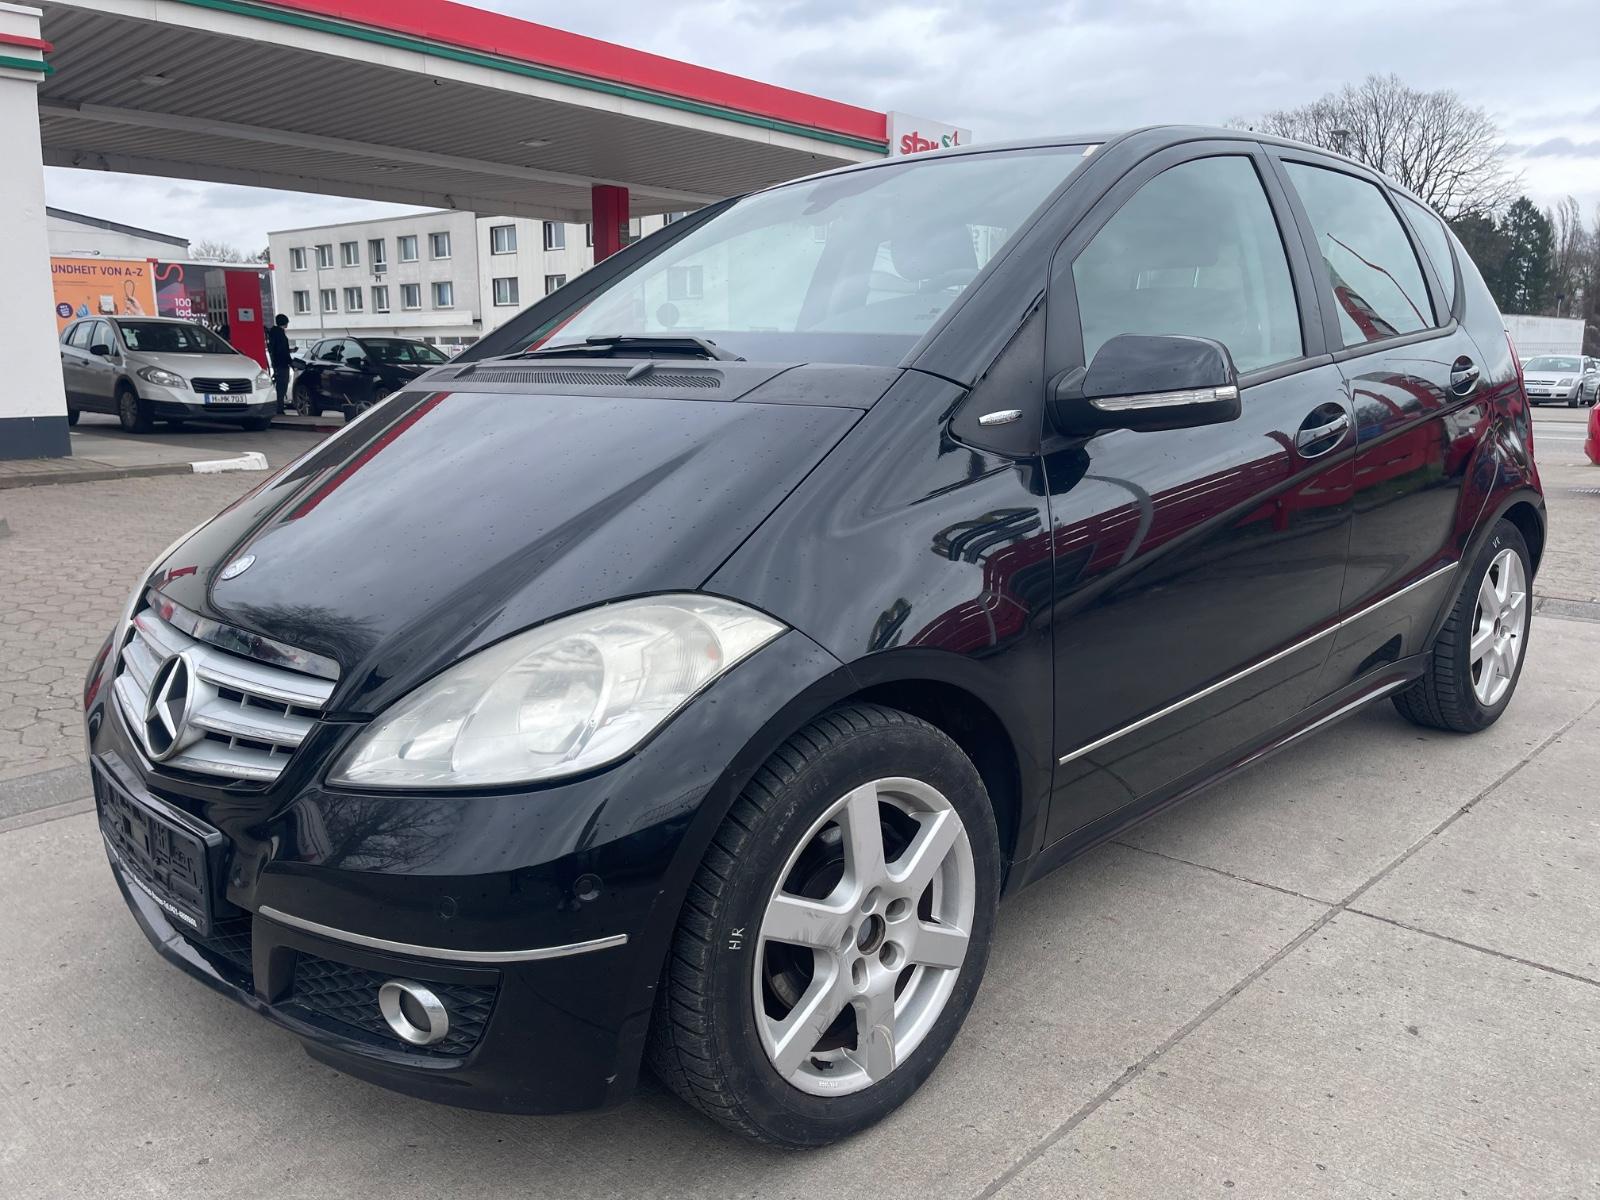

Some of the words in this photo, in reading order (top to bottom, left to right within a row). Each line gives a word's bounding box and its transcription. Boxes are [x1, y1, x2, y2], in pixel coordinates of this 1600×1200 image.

[100, 266, 122, 277] VON
[125, 267, 144, 277] A-Z
[175, 298, 192, 307] 100
[729, 928, 745, 950] HR
